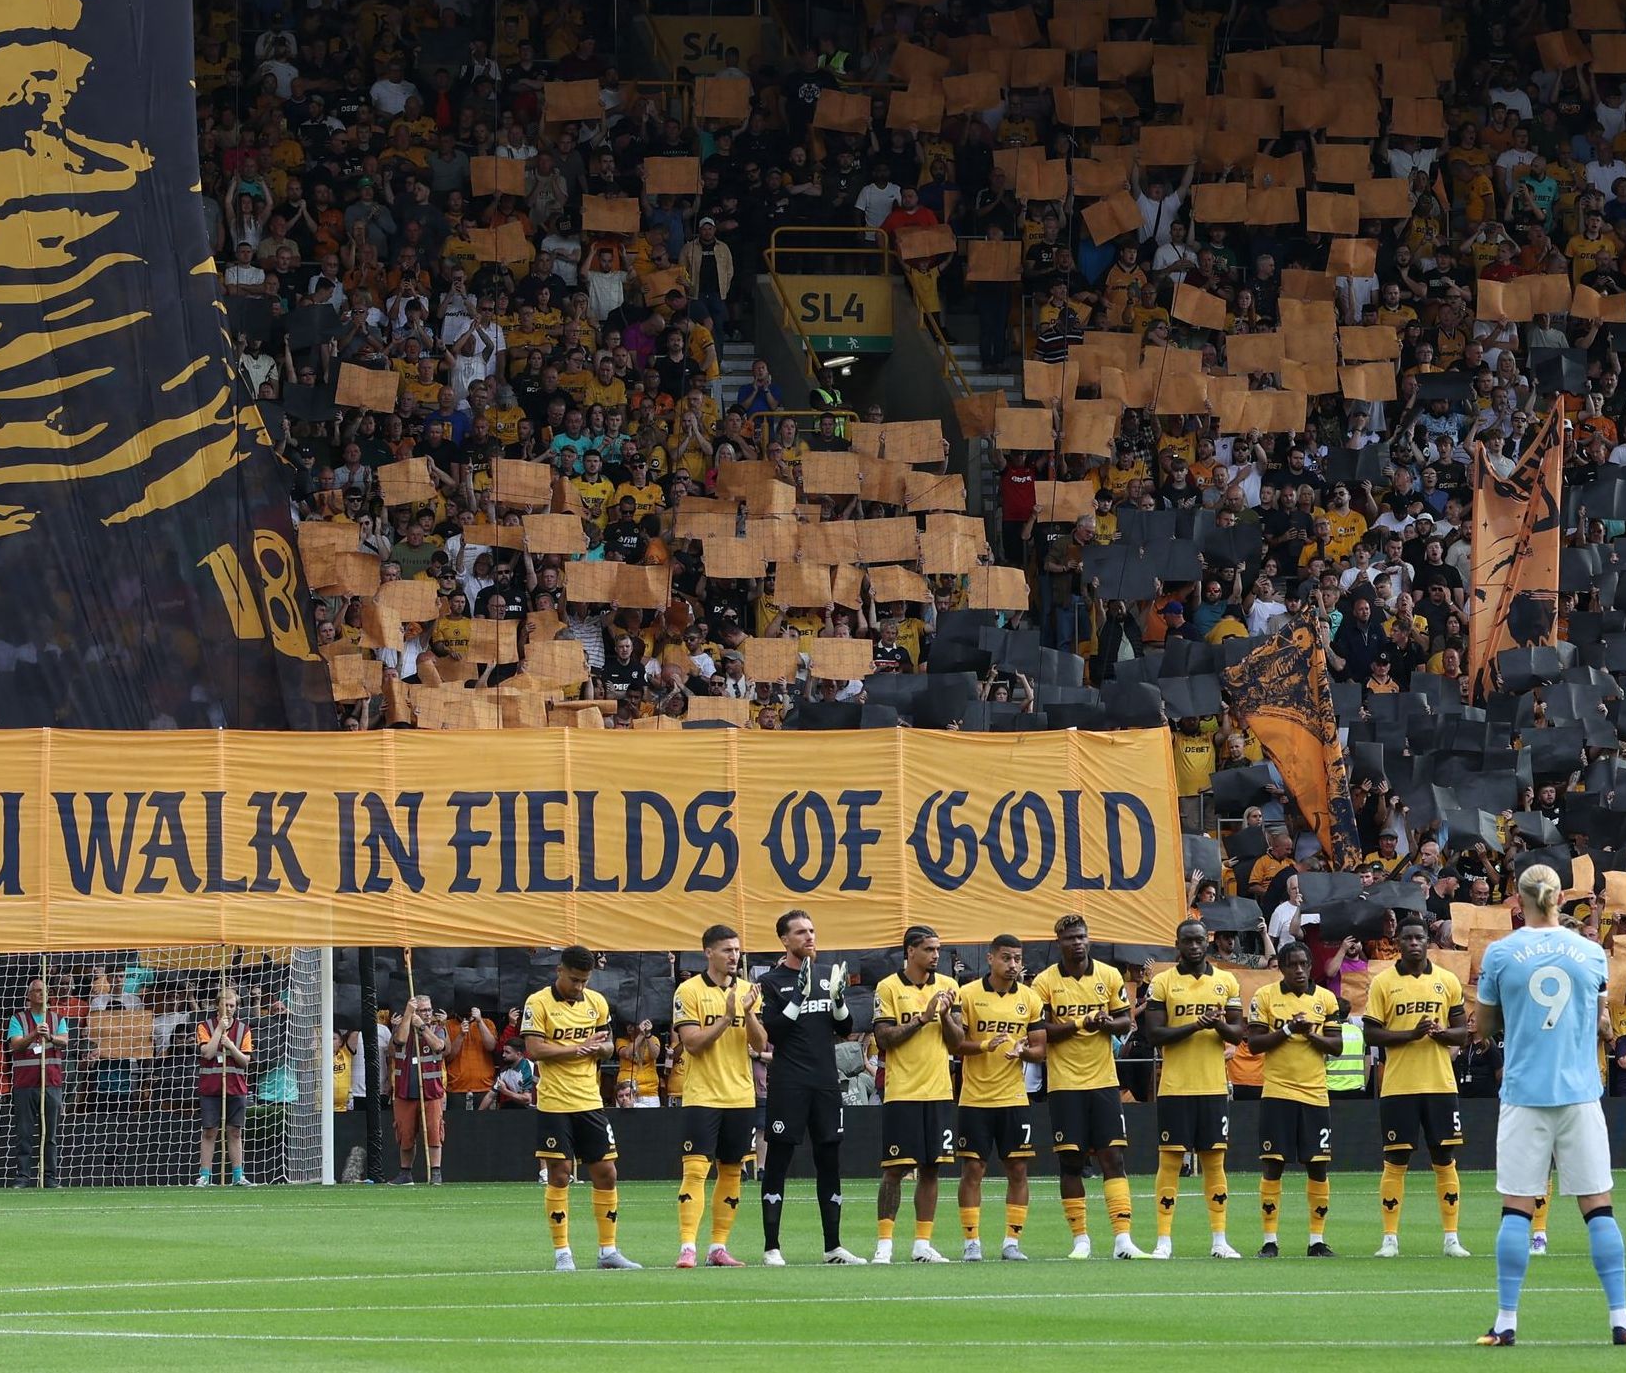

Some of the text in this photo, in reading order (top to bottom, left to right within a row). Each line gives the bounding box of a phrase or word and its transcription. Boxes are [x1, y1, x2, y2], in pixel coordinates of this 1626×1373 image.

[683, 32, 724, 61] S4
[340, 104, 358, 113] DEB
[1580, 251, 1596, 260] DEB
[801, 292, 864, 323] SL4
[444, 639, 470, 648] DEBET
[1184, 745, 1210, 755] DEBET
[54, 792, 309, 894] WALK
[336, 792, 424, 893] IN
[448, 791, 738, 892] FIELDS
[763, 790, 881, 892] OF
[907, 790, 1156, 891] GOLD
[1514, 939, 1587, 965] HAALAND
[1528, 965, 1572, 1030] 9
[800, 999, 832, 1014] EBET
[1056, 1003, 1105, 1017] DEBET
[1396, 1002, 1442, 1016] DEBET
[977, 1020, 1025, 1035] DEBET
[1453, 1111, 1463, 1132] 5
[942, 1129, 953, 1150] 2
[1021, 1124, 1032, 1144] 7
